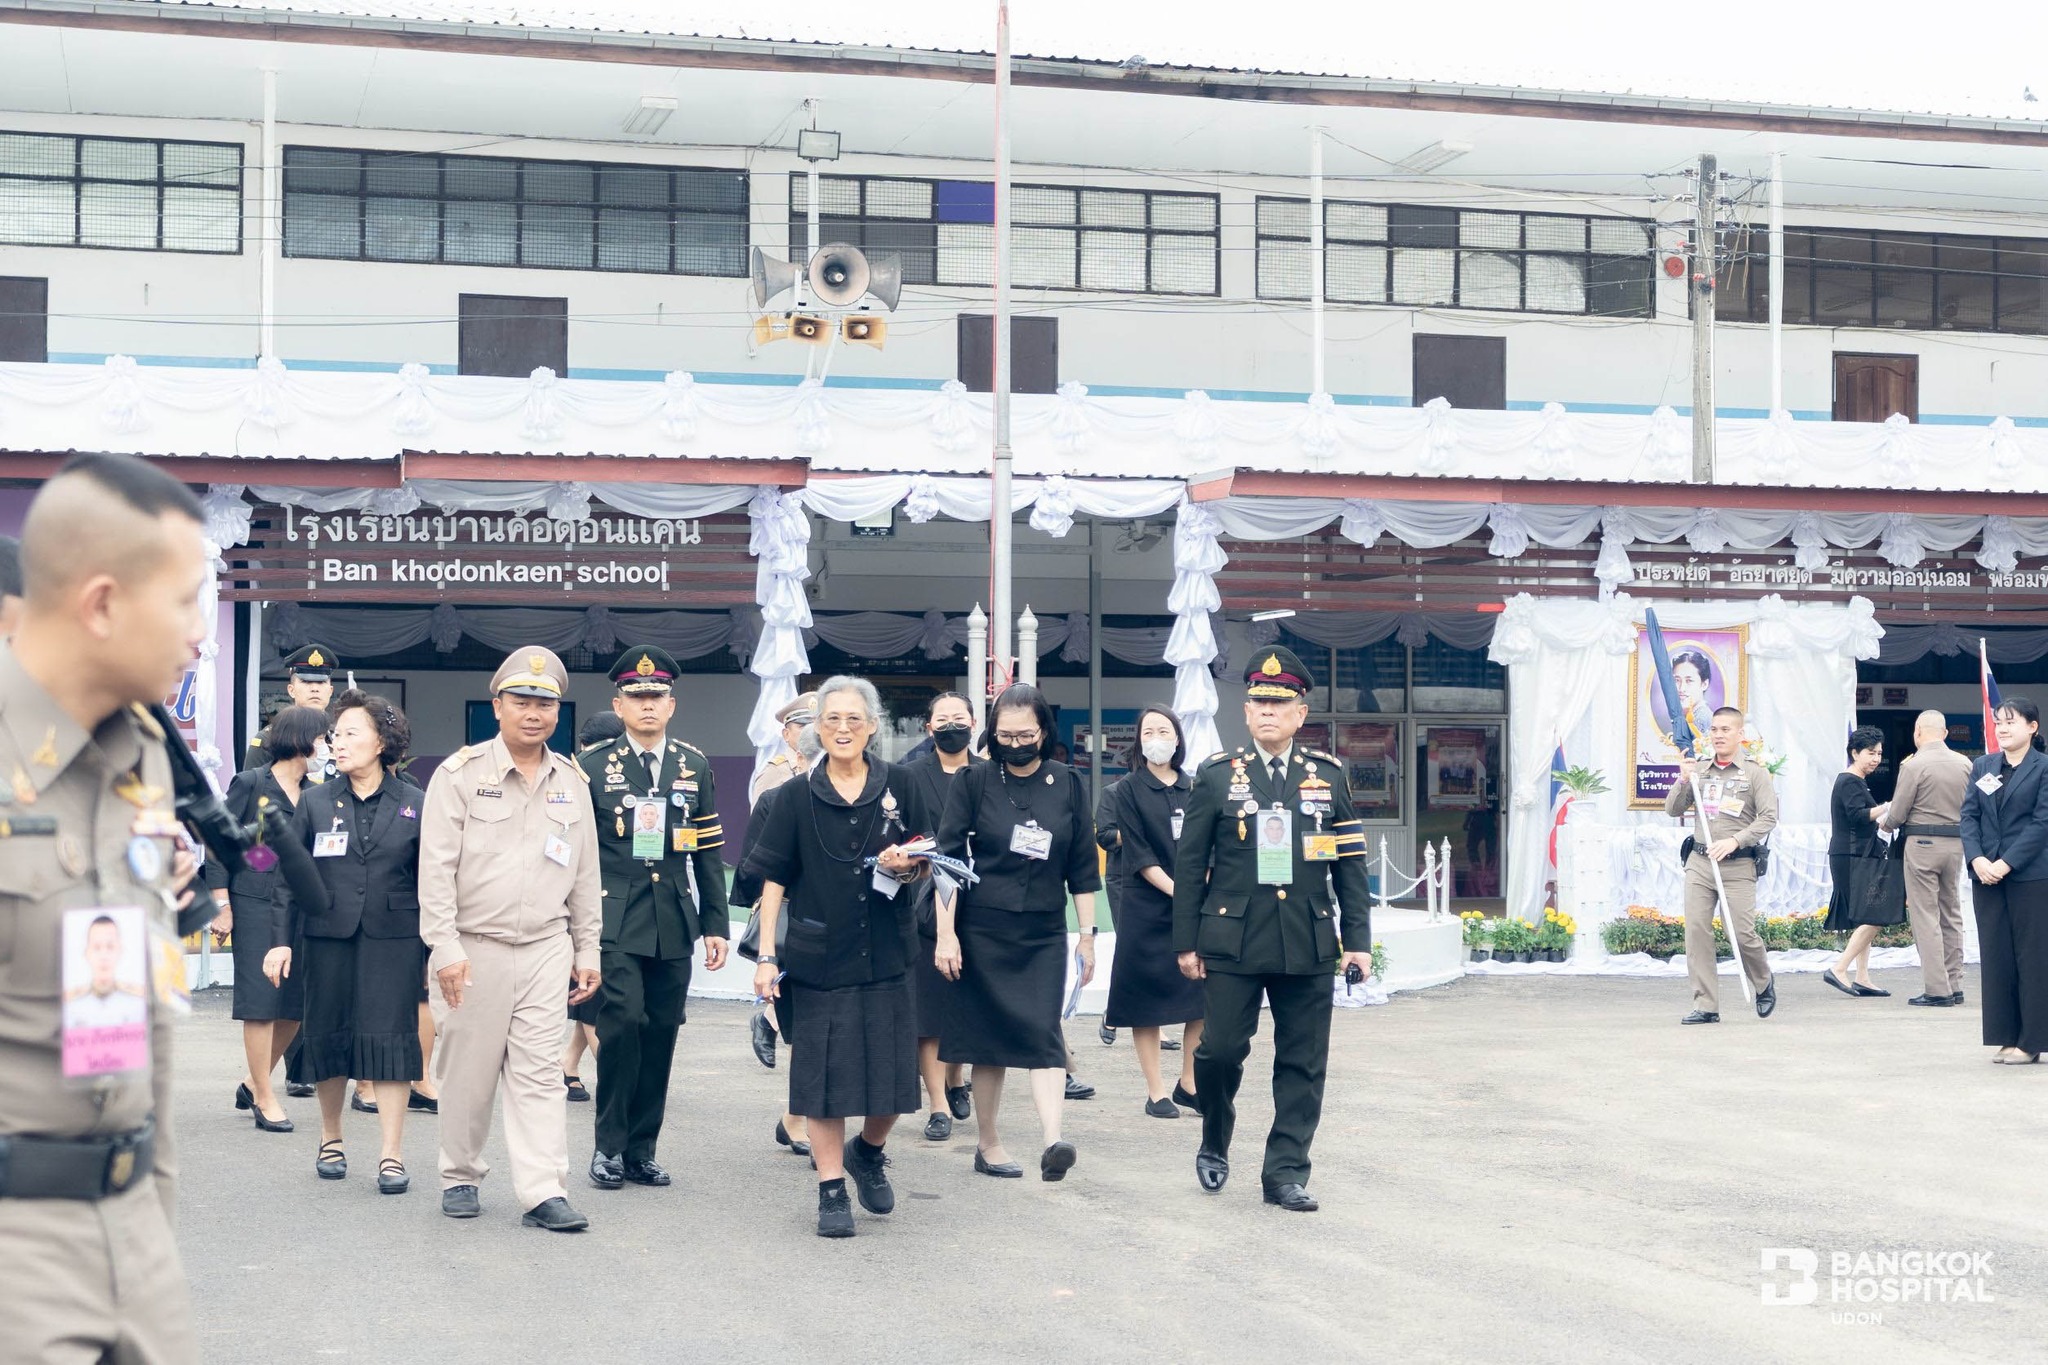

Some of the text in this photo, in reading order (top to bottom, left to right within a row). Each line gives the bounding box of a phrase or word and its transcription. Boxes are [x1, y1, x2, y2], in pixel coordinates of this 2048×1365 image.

[323, 558, 668, 584] Ban khodonkaen school
[1636, 556, 1711, 582] ประหยัด
[1729, 557, 1813, 584] อัธยาศัยด
[1830, 560, 1971, 587] มีความออนน้อม
